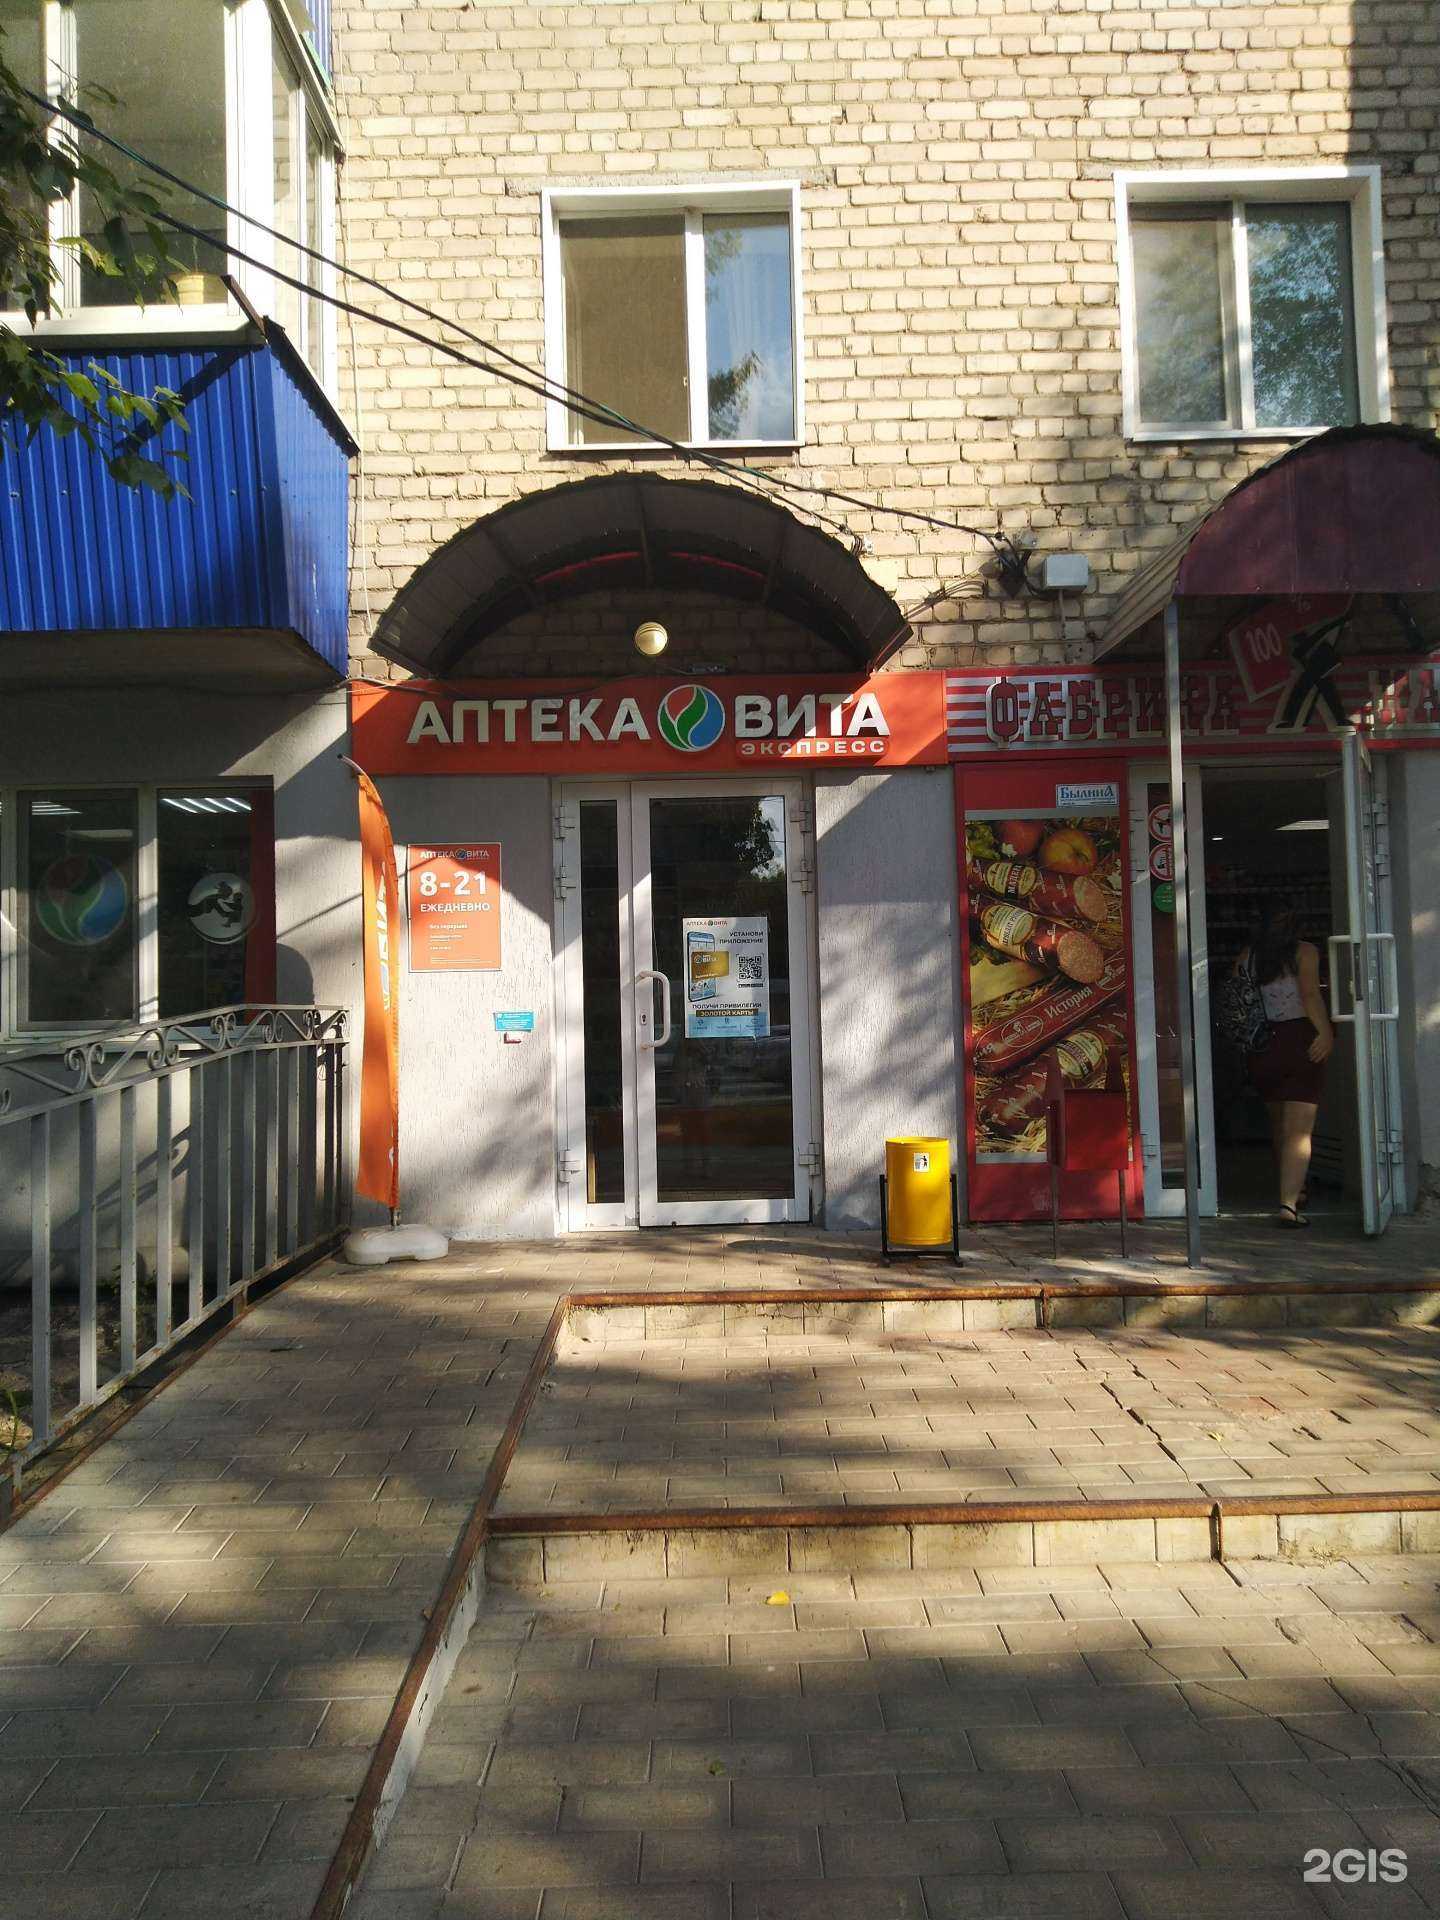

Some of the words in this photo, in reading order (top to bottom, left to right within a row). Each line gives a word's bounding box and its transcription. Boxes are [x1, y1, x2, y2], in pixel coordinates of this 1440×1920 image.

[406, 697, 650, 744] АПТЕКА
[735, 691, 891, 738] ВИТА
[741, 739, 886, 755] ЭКСПРЕСС
[420, 850, 455, 859] АПТЕКА
[466, 849, 489, 857] ВИТА
[420, 903, 491, 913] ЕЖЕДНЕВНО
[1044, 986, 1094, 1018] История
